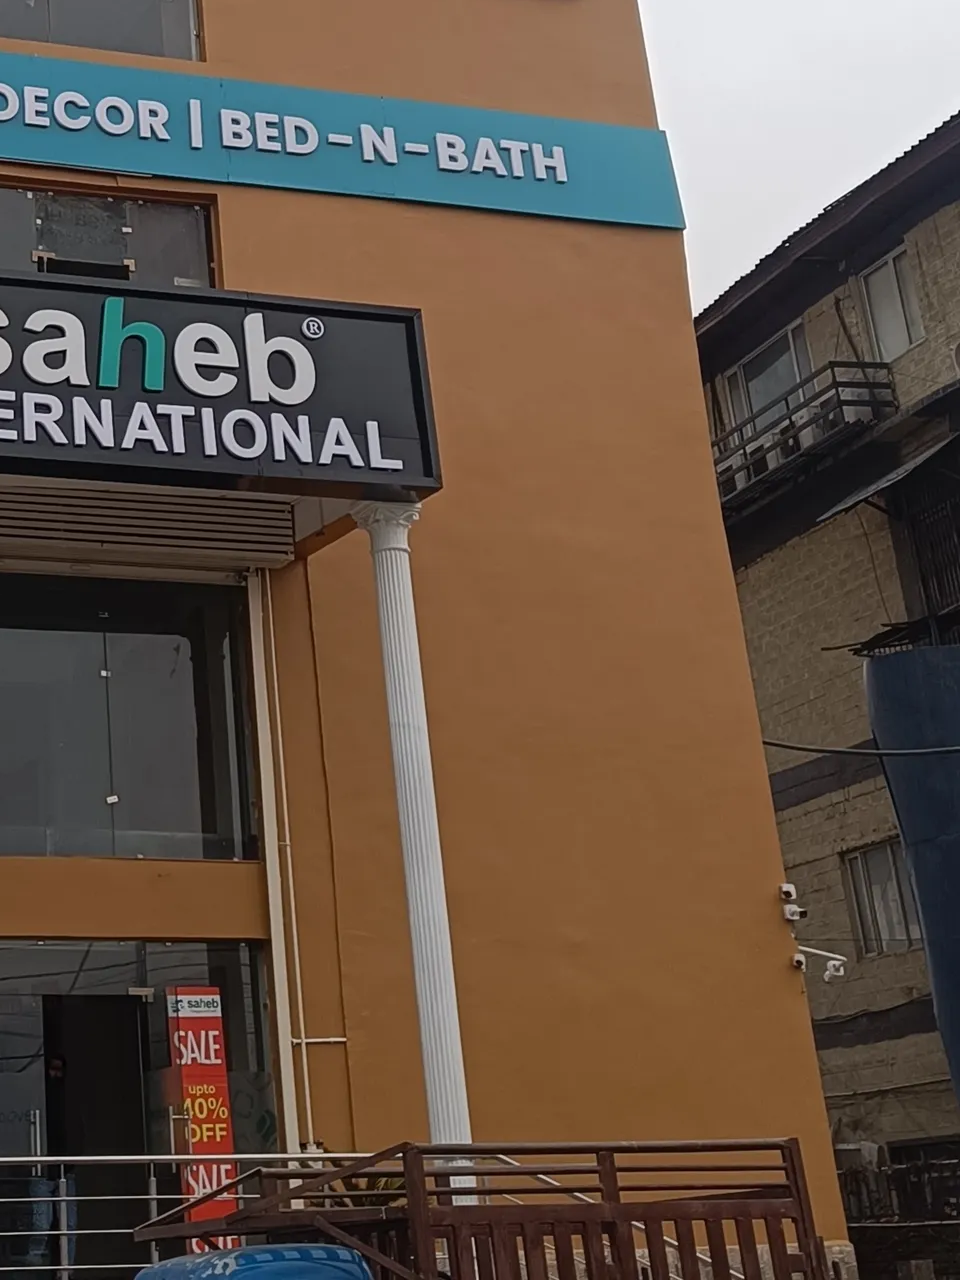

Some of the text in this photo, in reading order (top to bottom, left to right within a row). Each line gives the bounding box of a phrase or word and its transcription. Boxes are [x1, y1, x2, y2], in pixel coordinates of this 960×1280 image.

[187, 998, 219, 1009] saheb
[173, 1030, 222, 1065] SALE
[188, 1084, 216, 1097] upto
[185, 1124, 227, 1143] OFF
